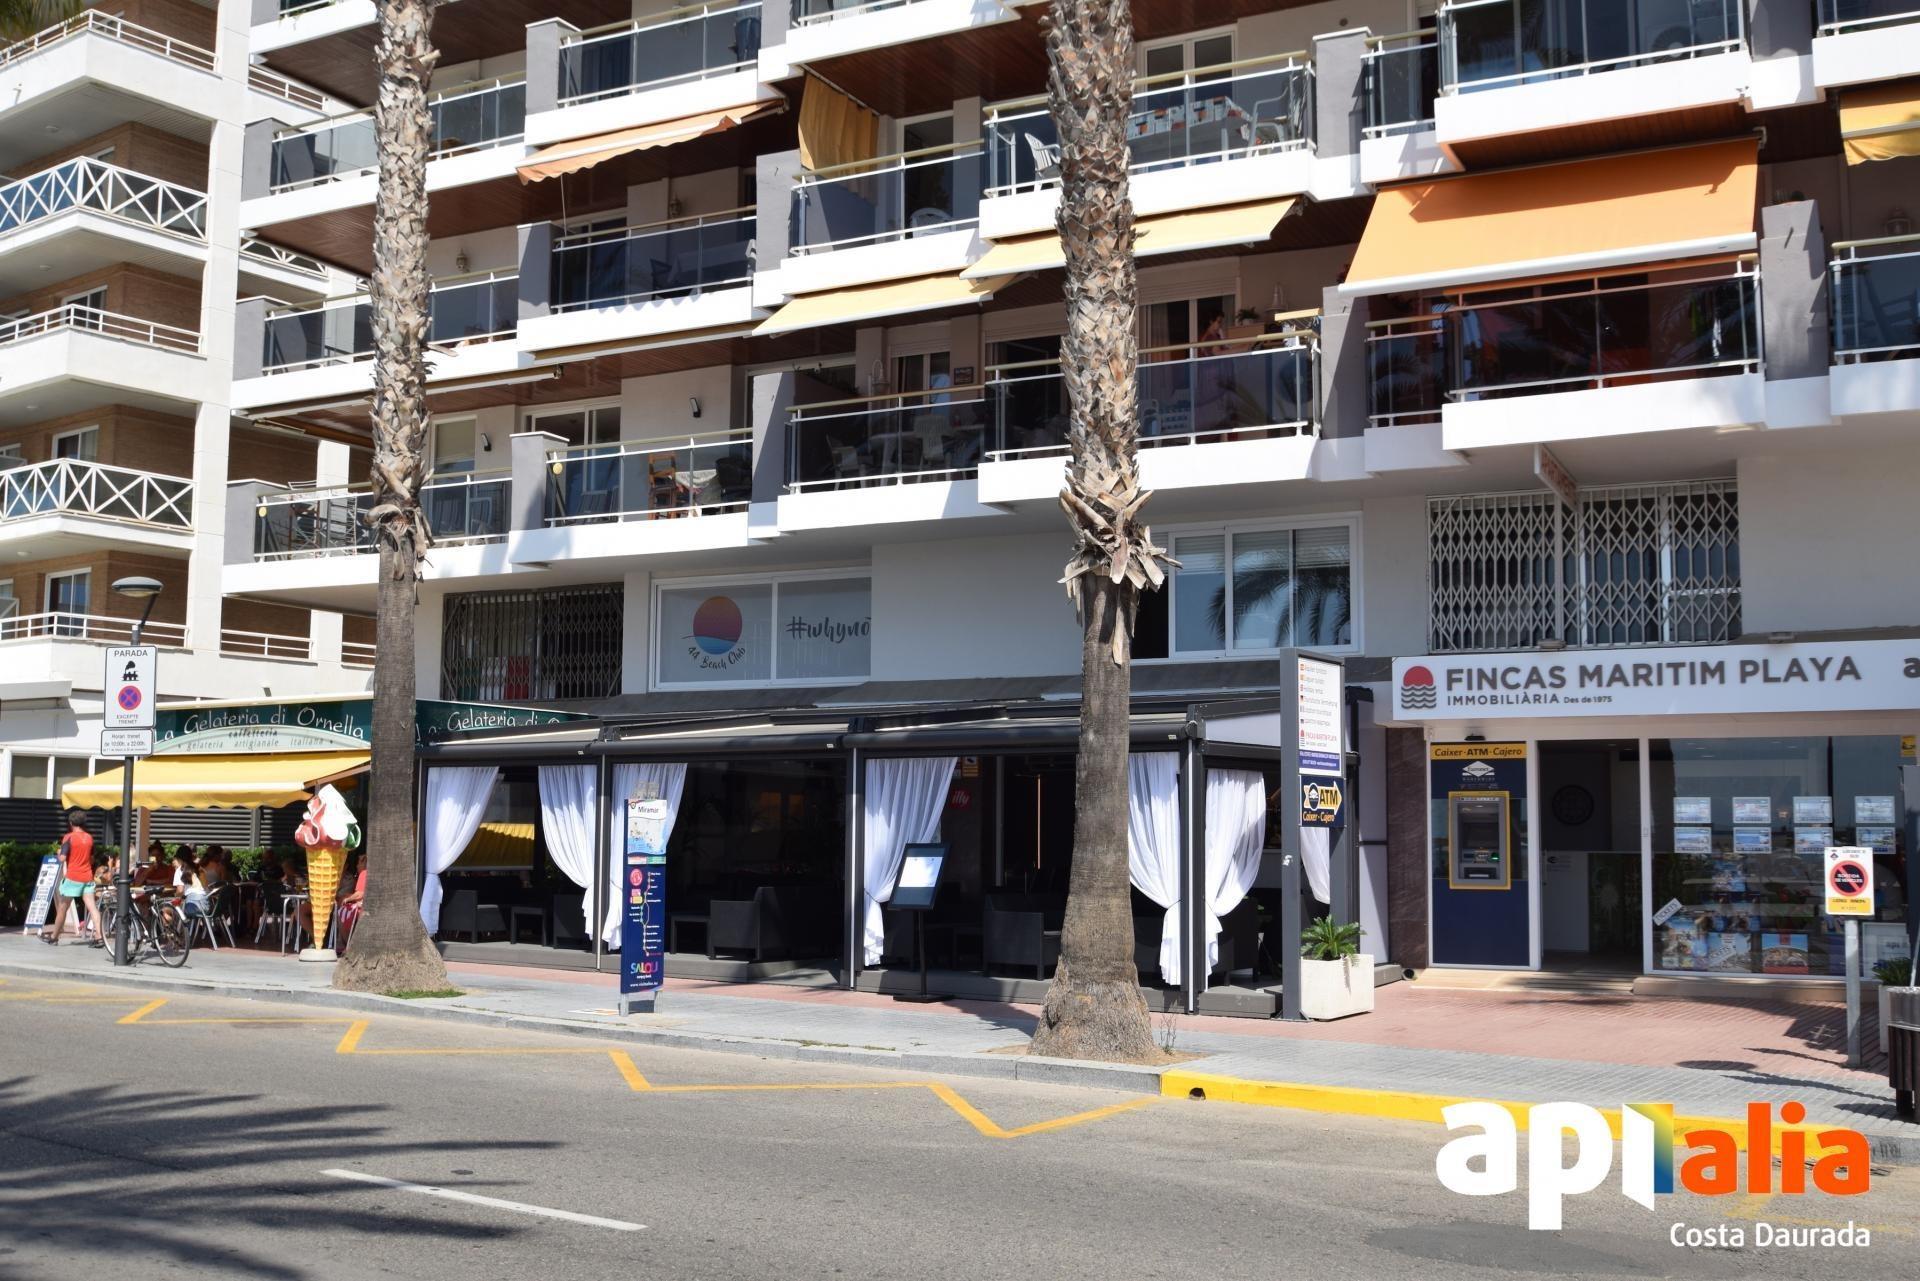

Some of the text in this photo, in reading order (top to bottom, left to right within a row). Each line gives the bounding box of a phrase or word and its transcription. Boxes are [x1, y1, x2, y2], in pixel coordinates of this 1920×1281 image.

[785, 615, 871, 644] #whyno
[114, 649, 148, 657] PARADA
[700, 655, 727, 669] Beach
[728, 647, 746, 664] Club
[1446, 665, 1567, 691] FINCAS
[1579, 660, 1725, 688] MARITIM
[1739, 655, 1862, 684] PLAYA
[1447, 691, 1613, 706] IMMOBILIÀRIA Des de 1975
[183, 709, 260, 734] Gelateria
[270, 704, 287, 725] di
[297, 706, 364, 740] Ornella
[447, 708, 516, 732] Gelateria
[188, 740, 223, 751] gelateria
[1435, 747, 1522, 757] Caixer ATM Cajero
[951, 790, 970, 807] illy
[1320, 789, 1338, 805] ATM
[638, 806, 659, 814] Miramar
[1302, 811, 1335, 823] Caixer Cajero
[630, 961, 659, 974] SALOU
